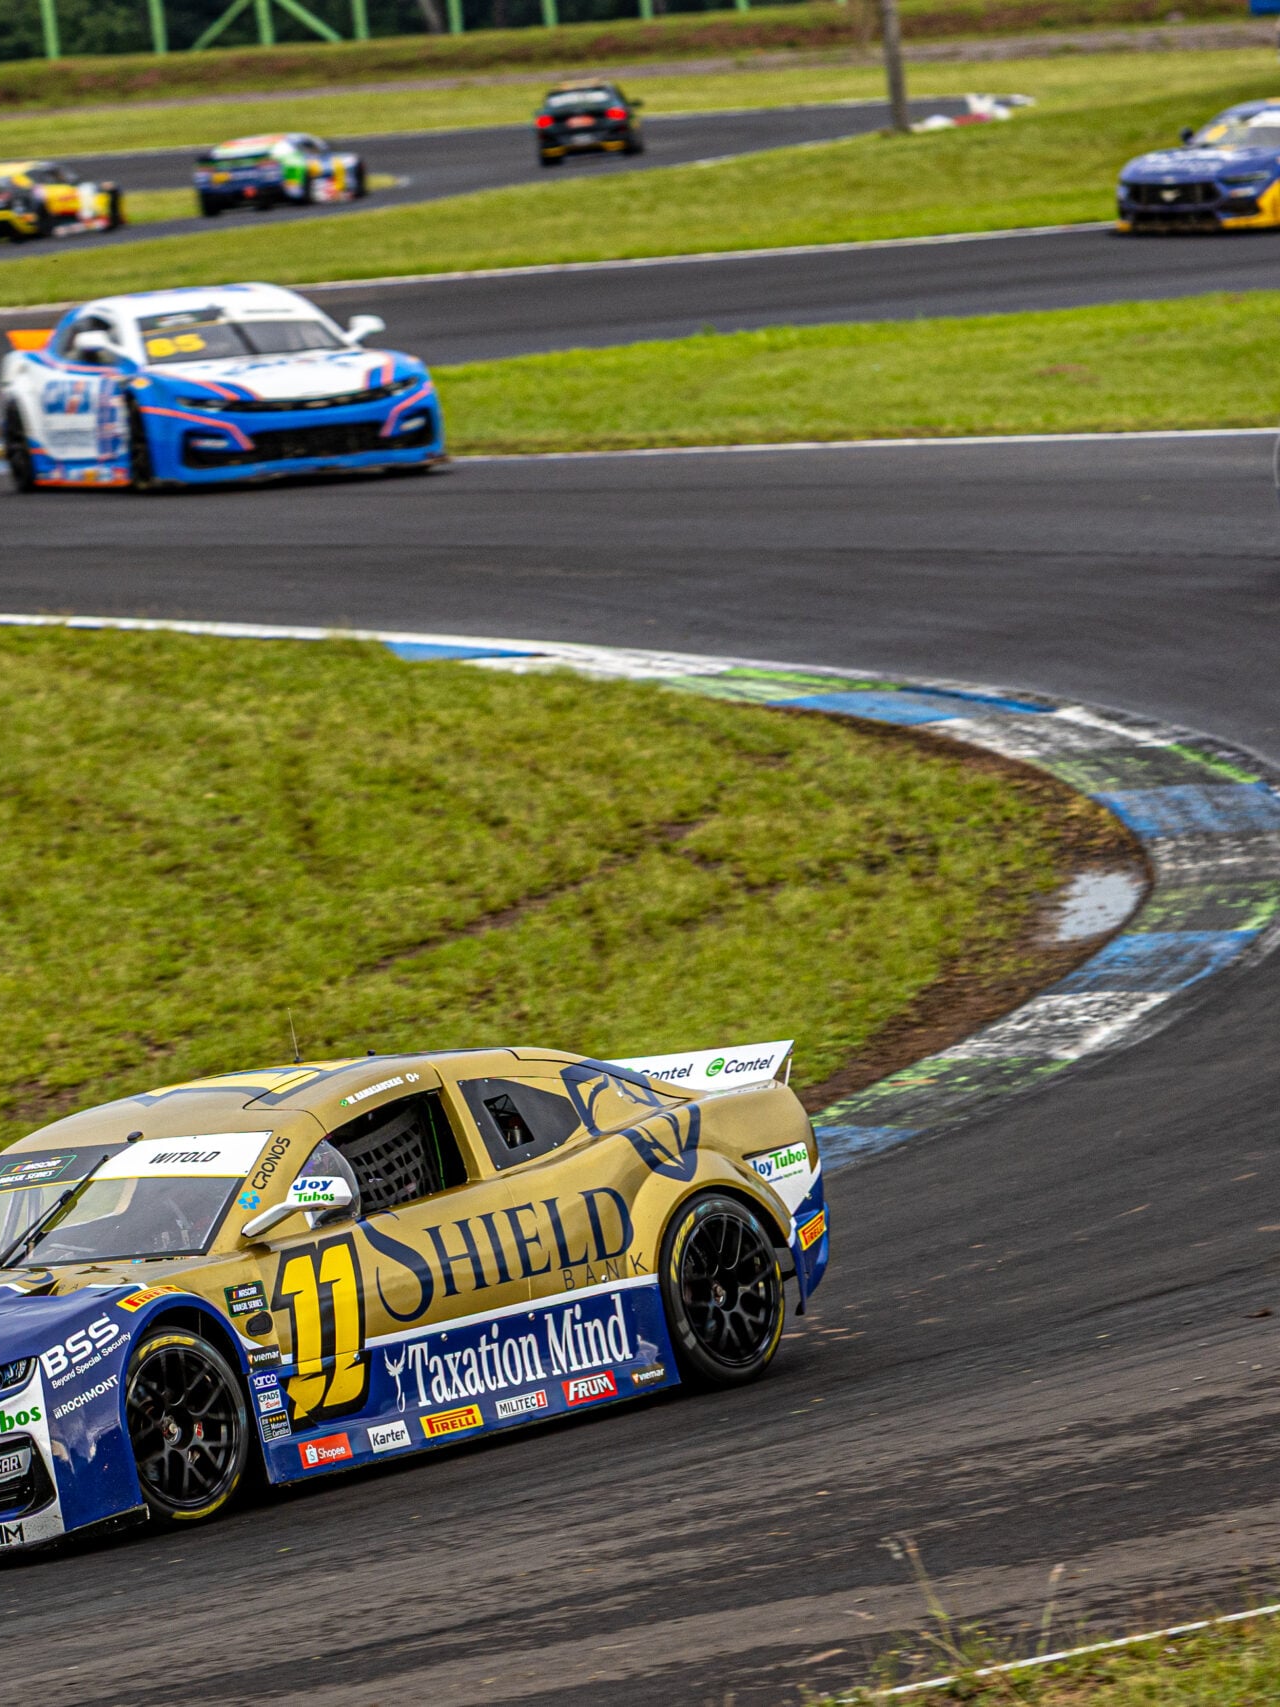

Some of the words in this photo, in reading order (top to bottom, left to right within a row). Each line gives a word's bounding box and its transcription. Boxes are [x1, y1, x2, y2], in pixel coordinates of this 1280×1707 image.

[724, 1055, 775, 1074] Contel
[149, 1151, 221, 1164] WITOLD
[251, 1136, 291, 1190] CRONOS
[292, 1178, 333, 1192] Joy
[294, 1191, 335, 1203] Tubos
[355, 1186, 634, 1322] SHIELD
[563, 1252, 649, 1291] BANK
[277, 1238, 368, 1422] 11
[39, 1316, 119, 1379] BSS
[51, 1369, 76, 1389] Beyond
[75, 1353, 102, 1374] Special
[103, 1332, 131, 1357] Security
[254, 1350, 279, 1363] viemar
[408, 1322, 546, 1407] Taxation
[544, 1293, 633, 1376] Mind
[62, 1375, 119, 1416] ROCHMONT
[570, 1373, 613, 1401] FRUM
[428, 1408, 477, 1434] PIRELLI
[372, 1429, 405, 1446] Karter
[318, 1446, 345, 1460] Shopee
